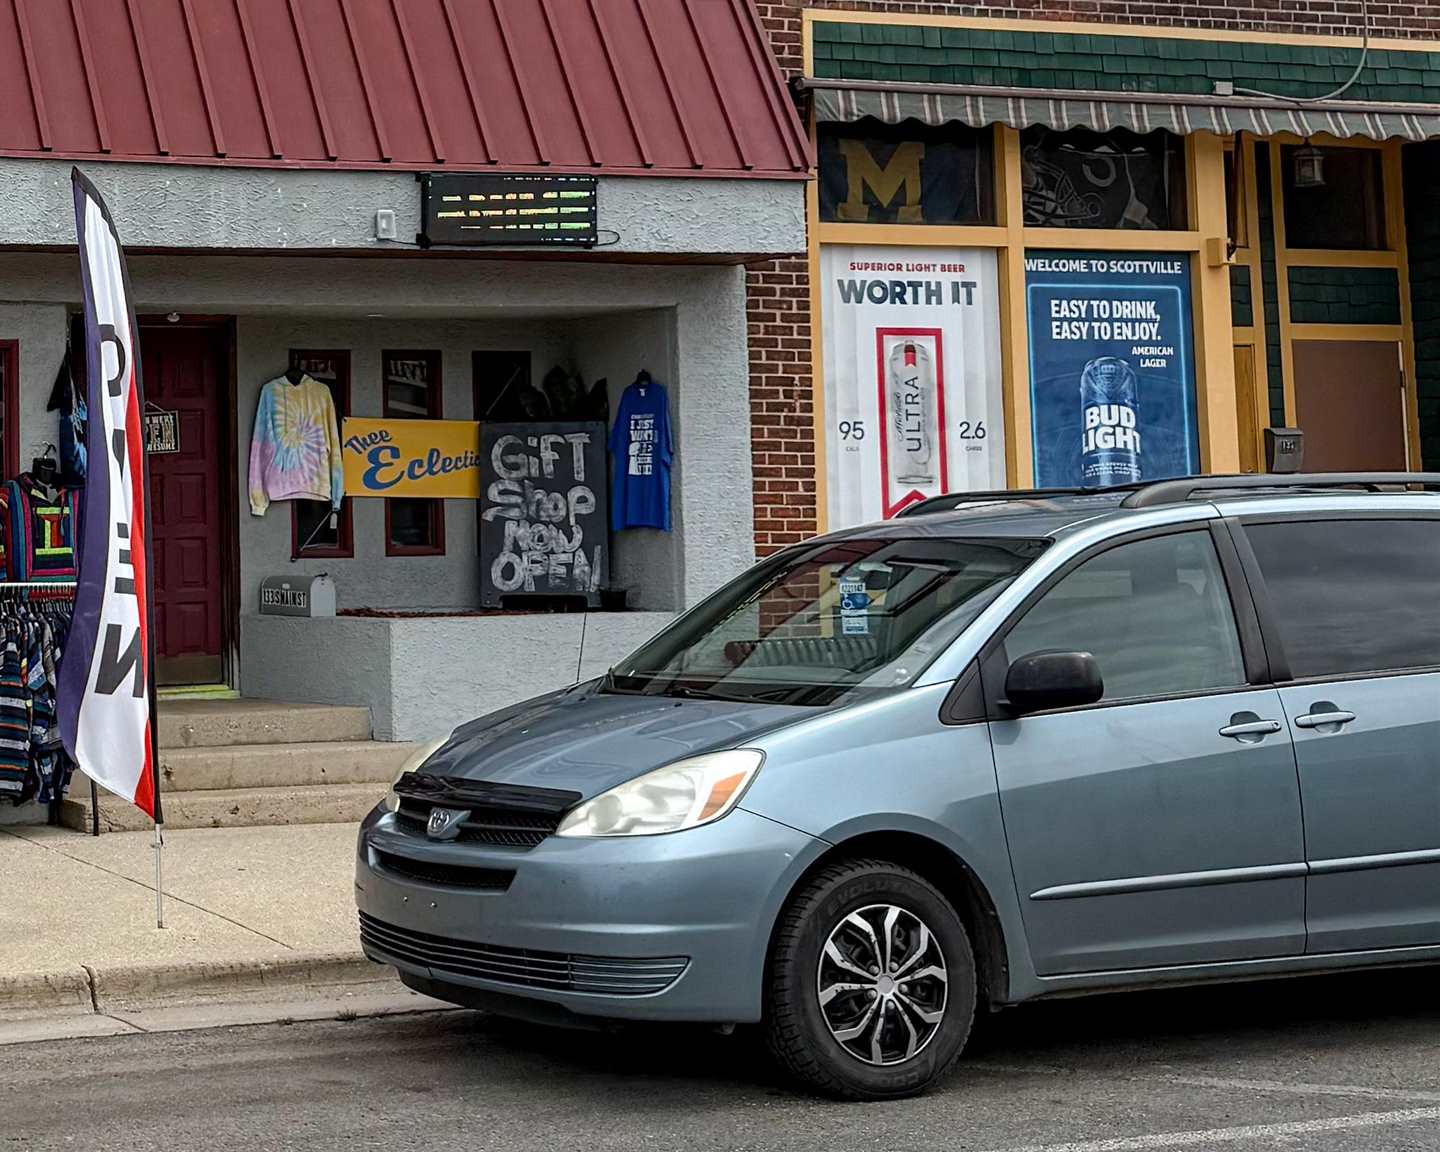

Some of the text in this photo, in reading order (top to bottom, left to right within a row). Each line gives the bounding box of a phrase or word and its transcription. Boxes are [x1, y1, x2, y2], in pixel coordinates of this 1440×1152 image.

[837, 138, 925, 223] M
[849, 262, 965, 273] SUPERIOR LIGHT BEER
[1025, 259, 1182, 274] WELCOME TO SCOTTVILLE
[837, 279, 977, 305] WORTH IT
[1051, 299, 1160, 321] EASY TO DRINK,
[1051, 321, 1161, 340] EASY TO ENJOY.
[1132, 346, 1173, 355] AMERICAN
[1140, 358, 1166, 368] LAGER
[904, 376, 922, 452] ULTRA
[1085, 404, 1136, 430] BUD
[839, 421, 865, 440] 95
[960, 421, 986, 439] 2.6
[491, 545, 601, 592] OPEN
